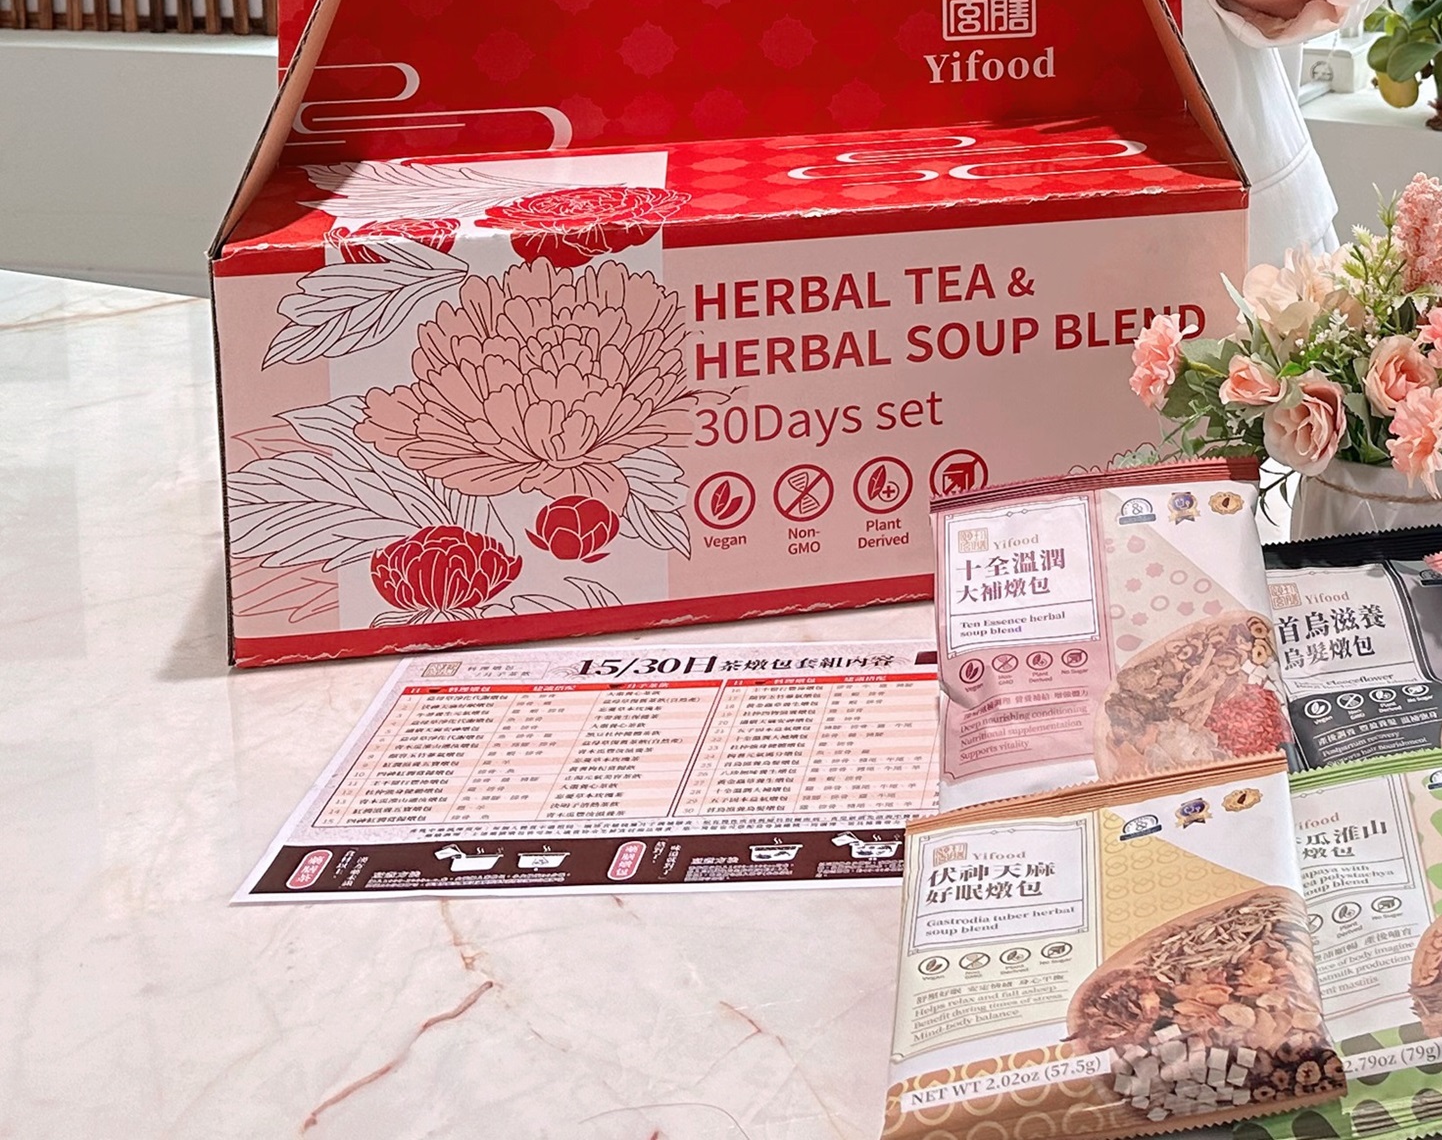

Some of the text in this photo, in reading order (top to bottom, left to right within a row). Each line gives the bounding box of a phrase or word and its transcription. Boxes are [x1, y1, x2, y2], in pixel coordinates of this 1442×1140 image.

[923, 46, 1056, 84] Yifood
[694, 263, 1035, 322] HERBAL TEA &
[694, 330, 892, 381] HERBAL
[906, 315, 1039, 363] SOUP
[694, 391, 943, 448] 30Days set
[788, 528, 820, 539] Non-
[866, 518, 901, 532] Plant
[704, 534, 747, 550] Vegan
[788, 541, 821, 555] GMO
[858, 532, 909, 549] Derived
[993, 534, 1039, 550] Yifood
[956, 577, 1051, 604] 大補燉包
[1305, 591, 1350, 605] Yifood
[960, 611, 1066, 629] Ten Essence herbal
[960, 625, 1022, 638] soup blend
[982, 711, 1031, 725] nourishing
[1031, 706, 1088, 718] conditioning
[961, 720, 1082, 747] Nutritional supplementation
[960, 740, 1030, 760] Supports vitality
[1299, 812, 1340, 830] ifood
[972, 851, 1026, 861] Yifood
[1301, 867, 1338, 880] apaya
[1332, 878, 1369, 888] blend
[925, 880, 1043, 906] 好眠燉包
[926, 906, 1075, 927] Gastrodia tuber herbal
[925, 923, 999, 936] soup blend
[1356, 954, 1412, 974] production
[915, 985, 1057, 1017] Helps relax and fall asleep
[914, 1013, 950, 1029] Benefit
[952, 1005, 987, 1018] during
[989, 1000, 1018, 1009] times
[1032, 993, 1063, 1002] stress
[975, 1009, 1019, 1022] balance
[1401, 1042, 1441, 1066] (79g)
[911, 1056, 1101, 1106] NET WT 2.02oz (57.5g)
